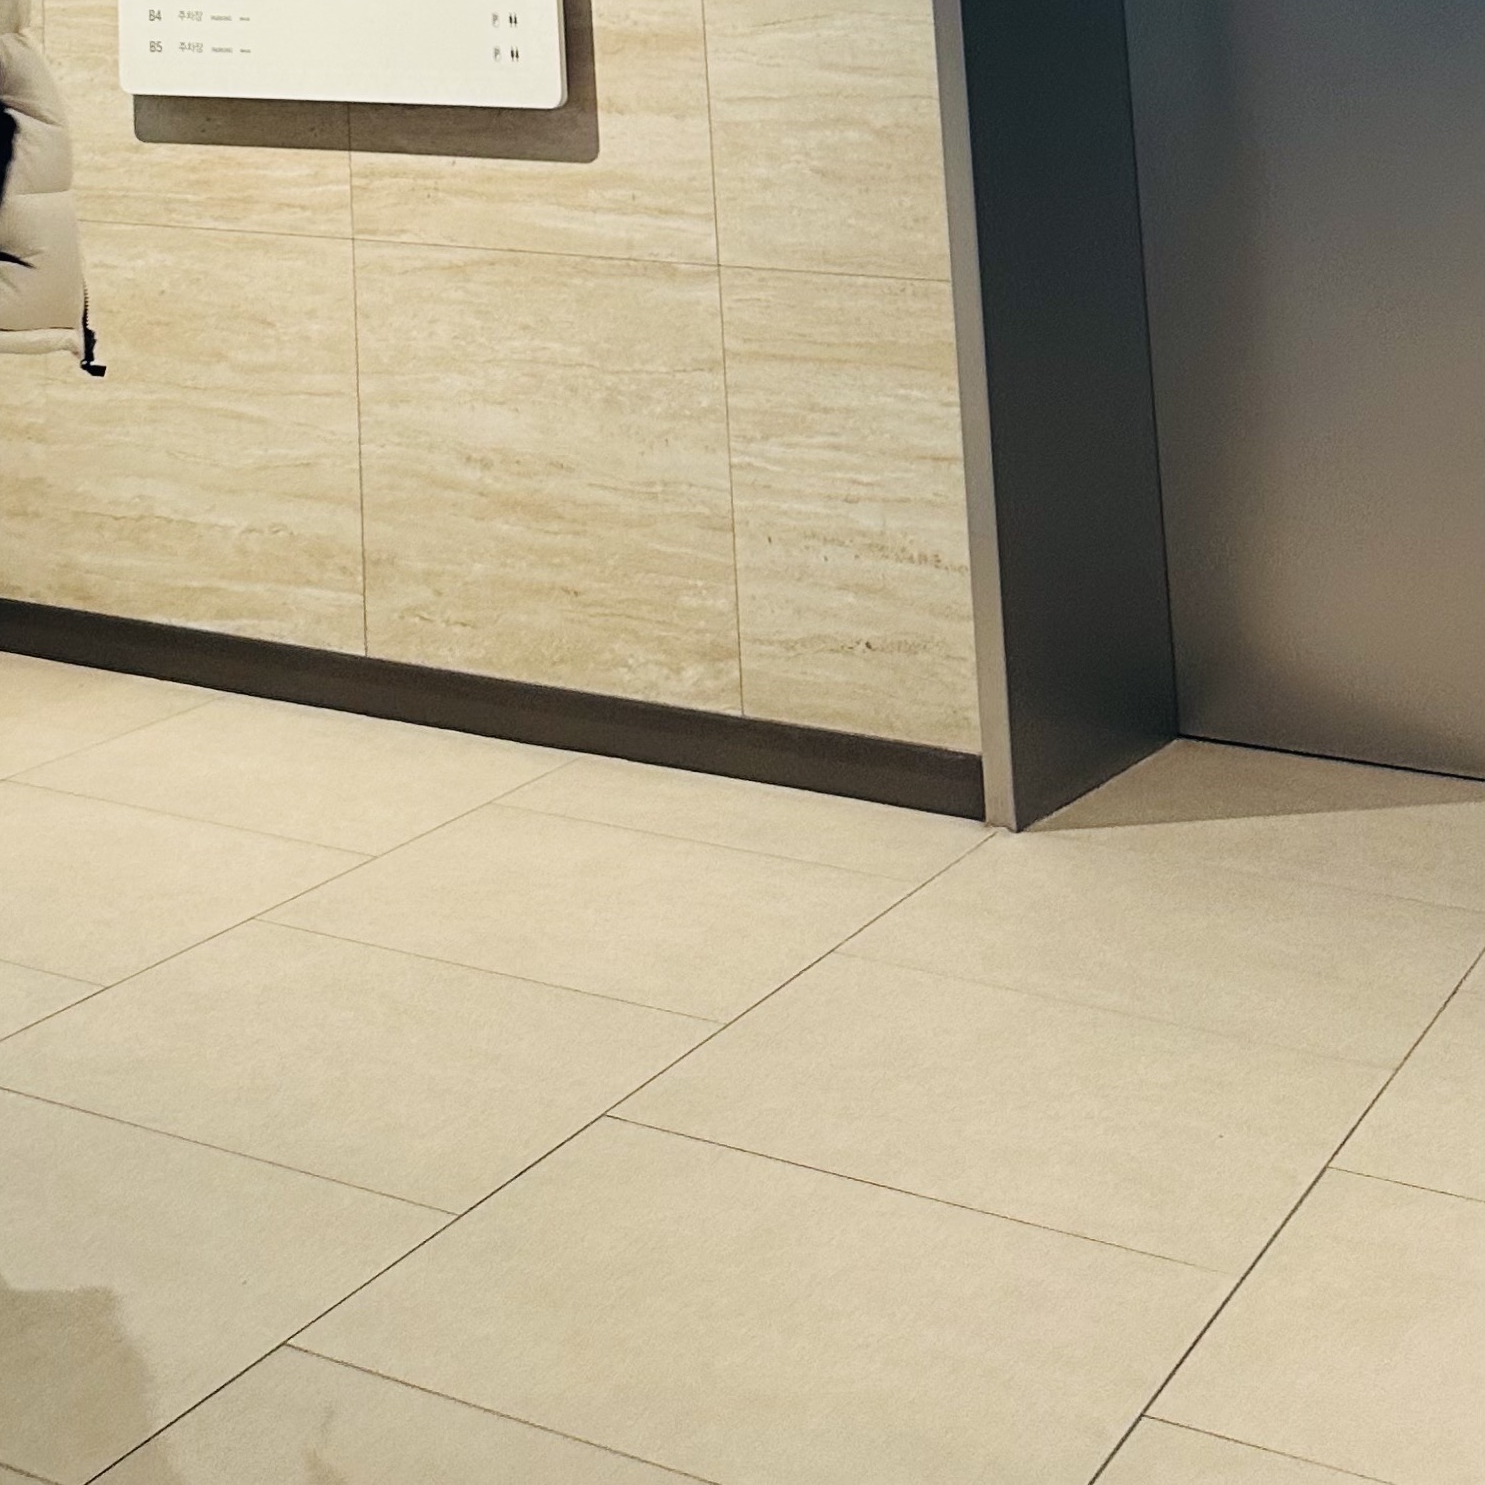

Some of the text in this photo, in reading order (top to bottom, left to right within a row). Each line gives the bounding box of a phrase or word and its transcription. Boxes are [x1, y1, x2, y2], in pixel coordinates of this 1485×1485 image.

[149, 10, 162, 22] B4
[178, 11, 203, 21] 주차장
[150, 41, 162, 52] B5
[178, 42, 203, 53] 주차장
